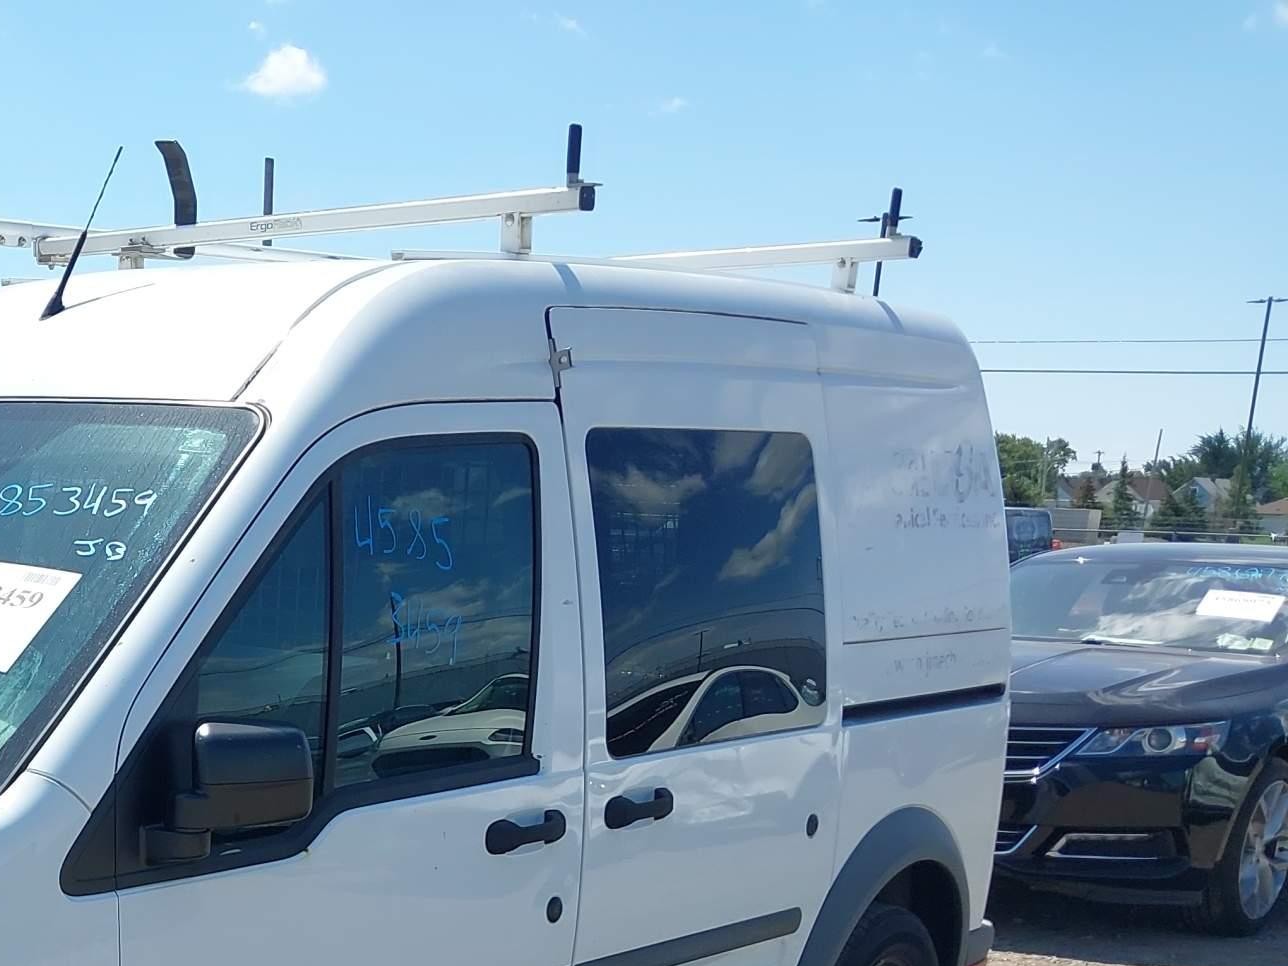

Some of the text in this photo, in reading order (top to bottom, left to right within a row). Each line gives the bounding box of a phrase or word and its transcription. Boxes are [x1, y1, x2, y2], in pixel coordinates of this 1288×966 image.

[72, 537, 128, 562] JB
[353, 495, 456, 571] 4585
[387, 591, 463, 665] 3459
